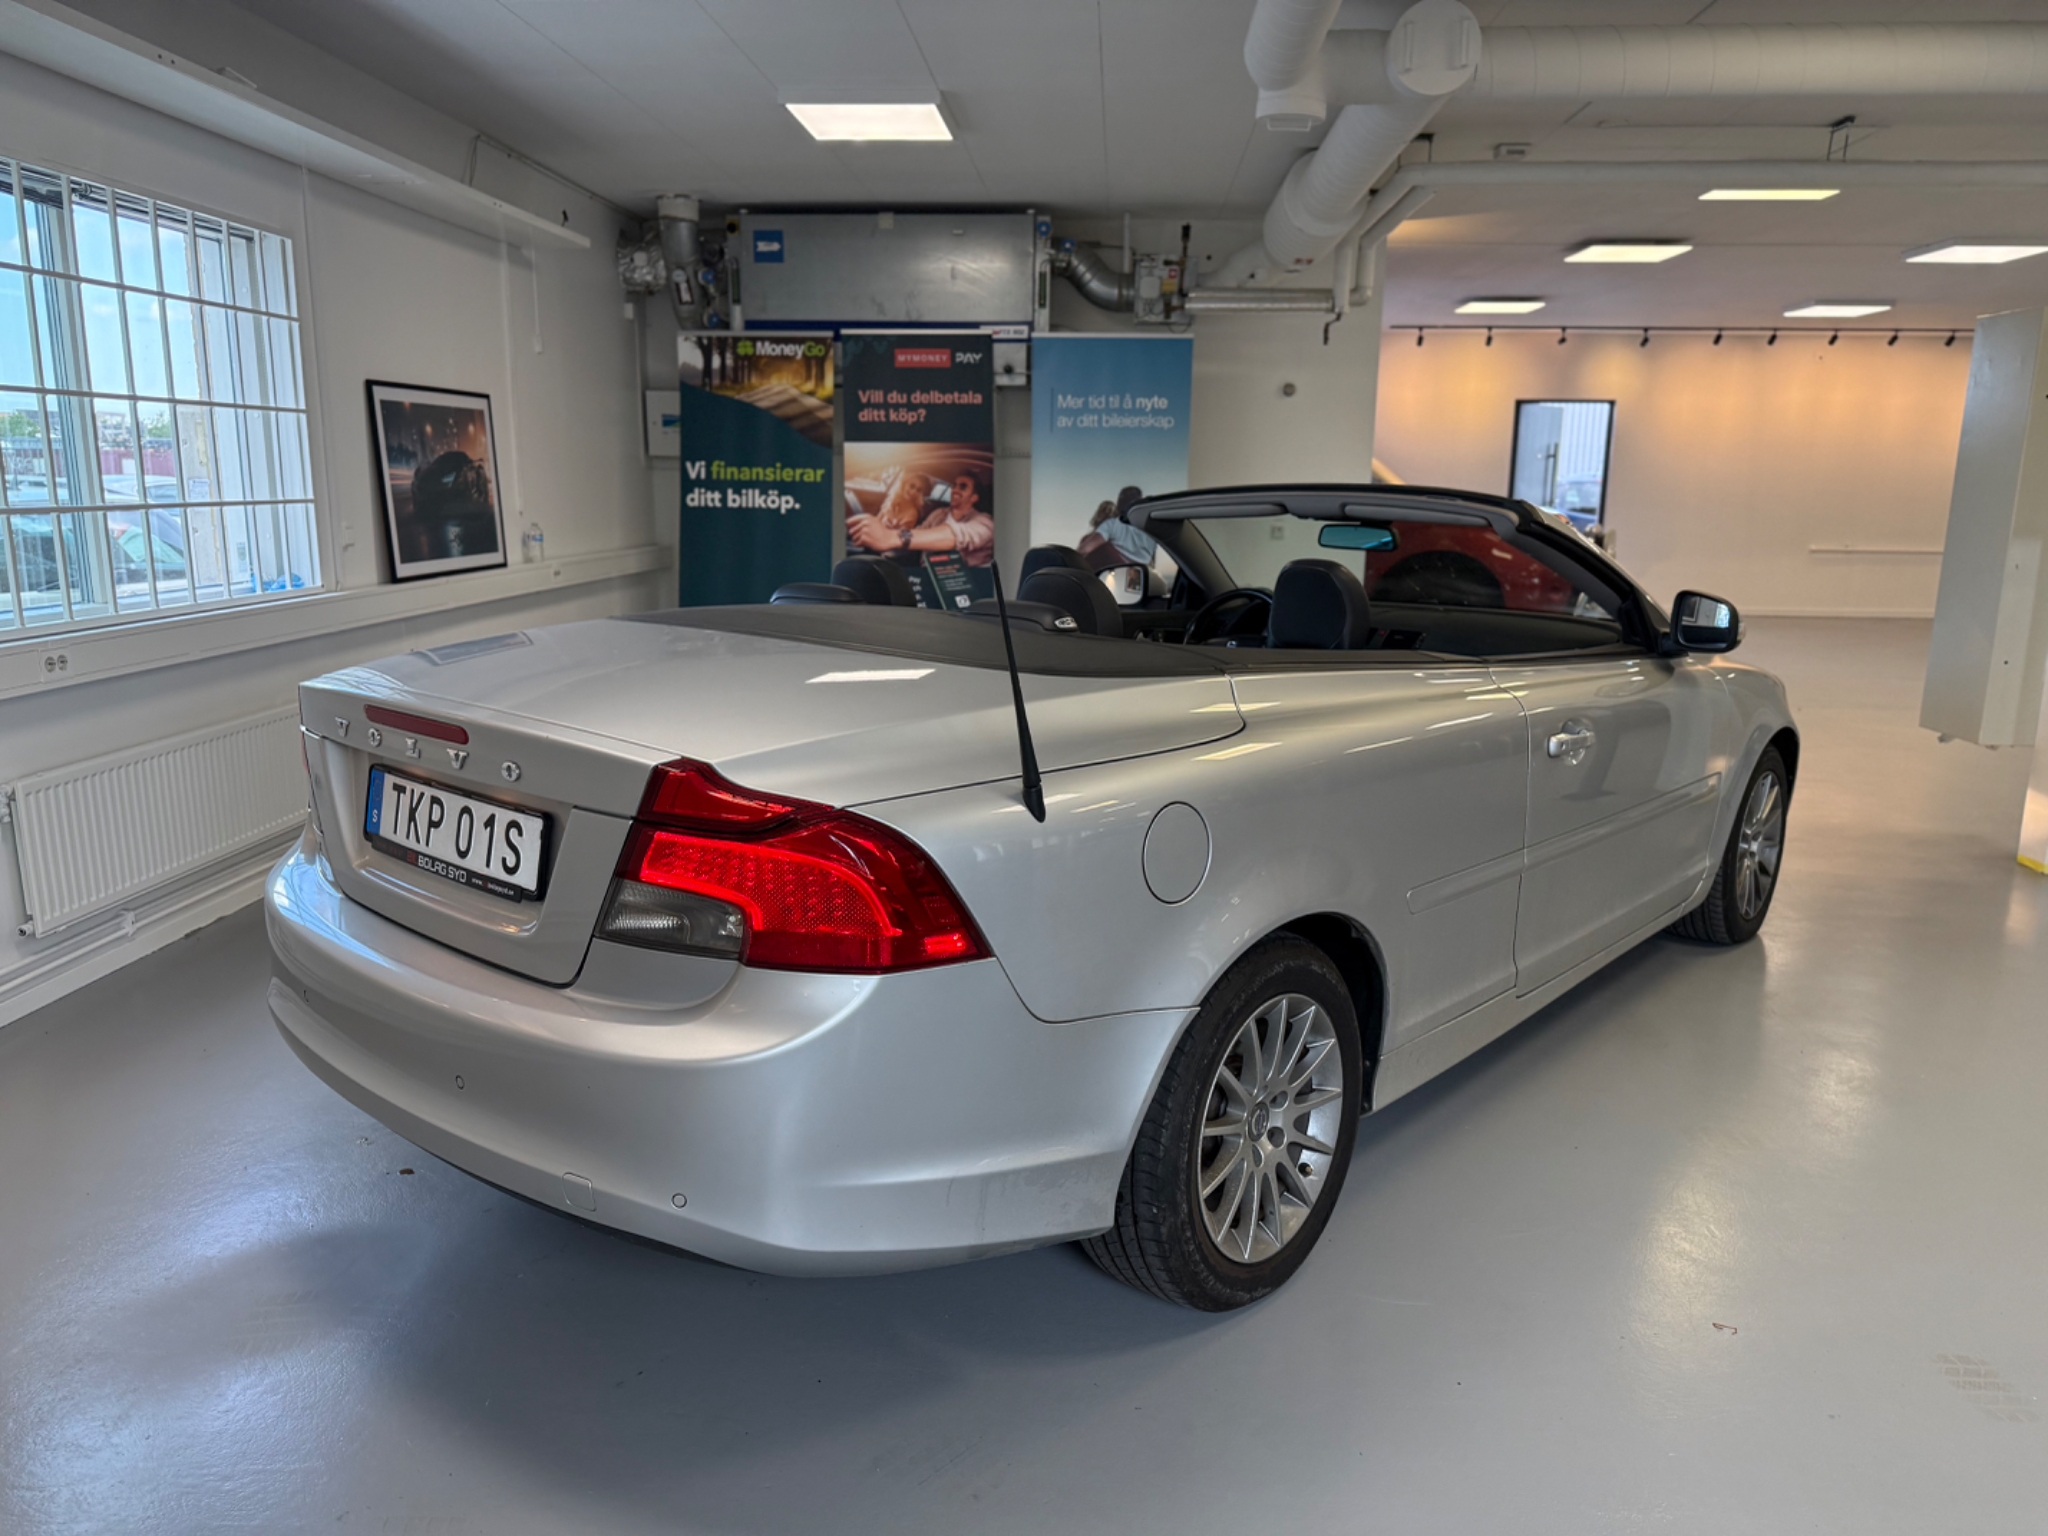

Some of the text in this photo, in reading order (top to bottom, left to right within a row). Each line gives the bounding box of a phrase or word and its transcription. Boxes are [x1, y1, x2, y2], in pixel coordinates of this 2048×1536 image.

[756, 341, 825, 359] MoneyGo
[898, 353, 982, 364] MYMONEY PAY
[858, 390, 983, 404] Vill du delbetala
[1057, 394, 1085, 409] Mer
[1088, 394, 1106, 409] tid
[1123, 392, 1133, 409] å
[1136, 394, 1168, 412] nyte
[858, 408, 927, 425] ditt köp?
[1057, 413, 1175, 430] av ditt bileierskap
[685, 460, 825, 482] Vi finansierar
[685, 488, 801, 514] ditt bilköp.
[335, 716, 521, 782] VOLVO
[372, 809, 378, 823] S
[392, 782, 523, 875] TKP 01S
[448, 867, 467, 883] SYD
